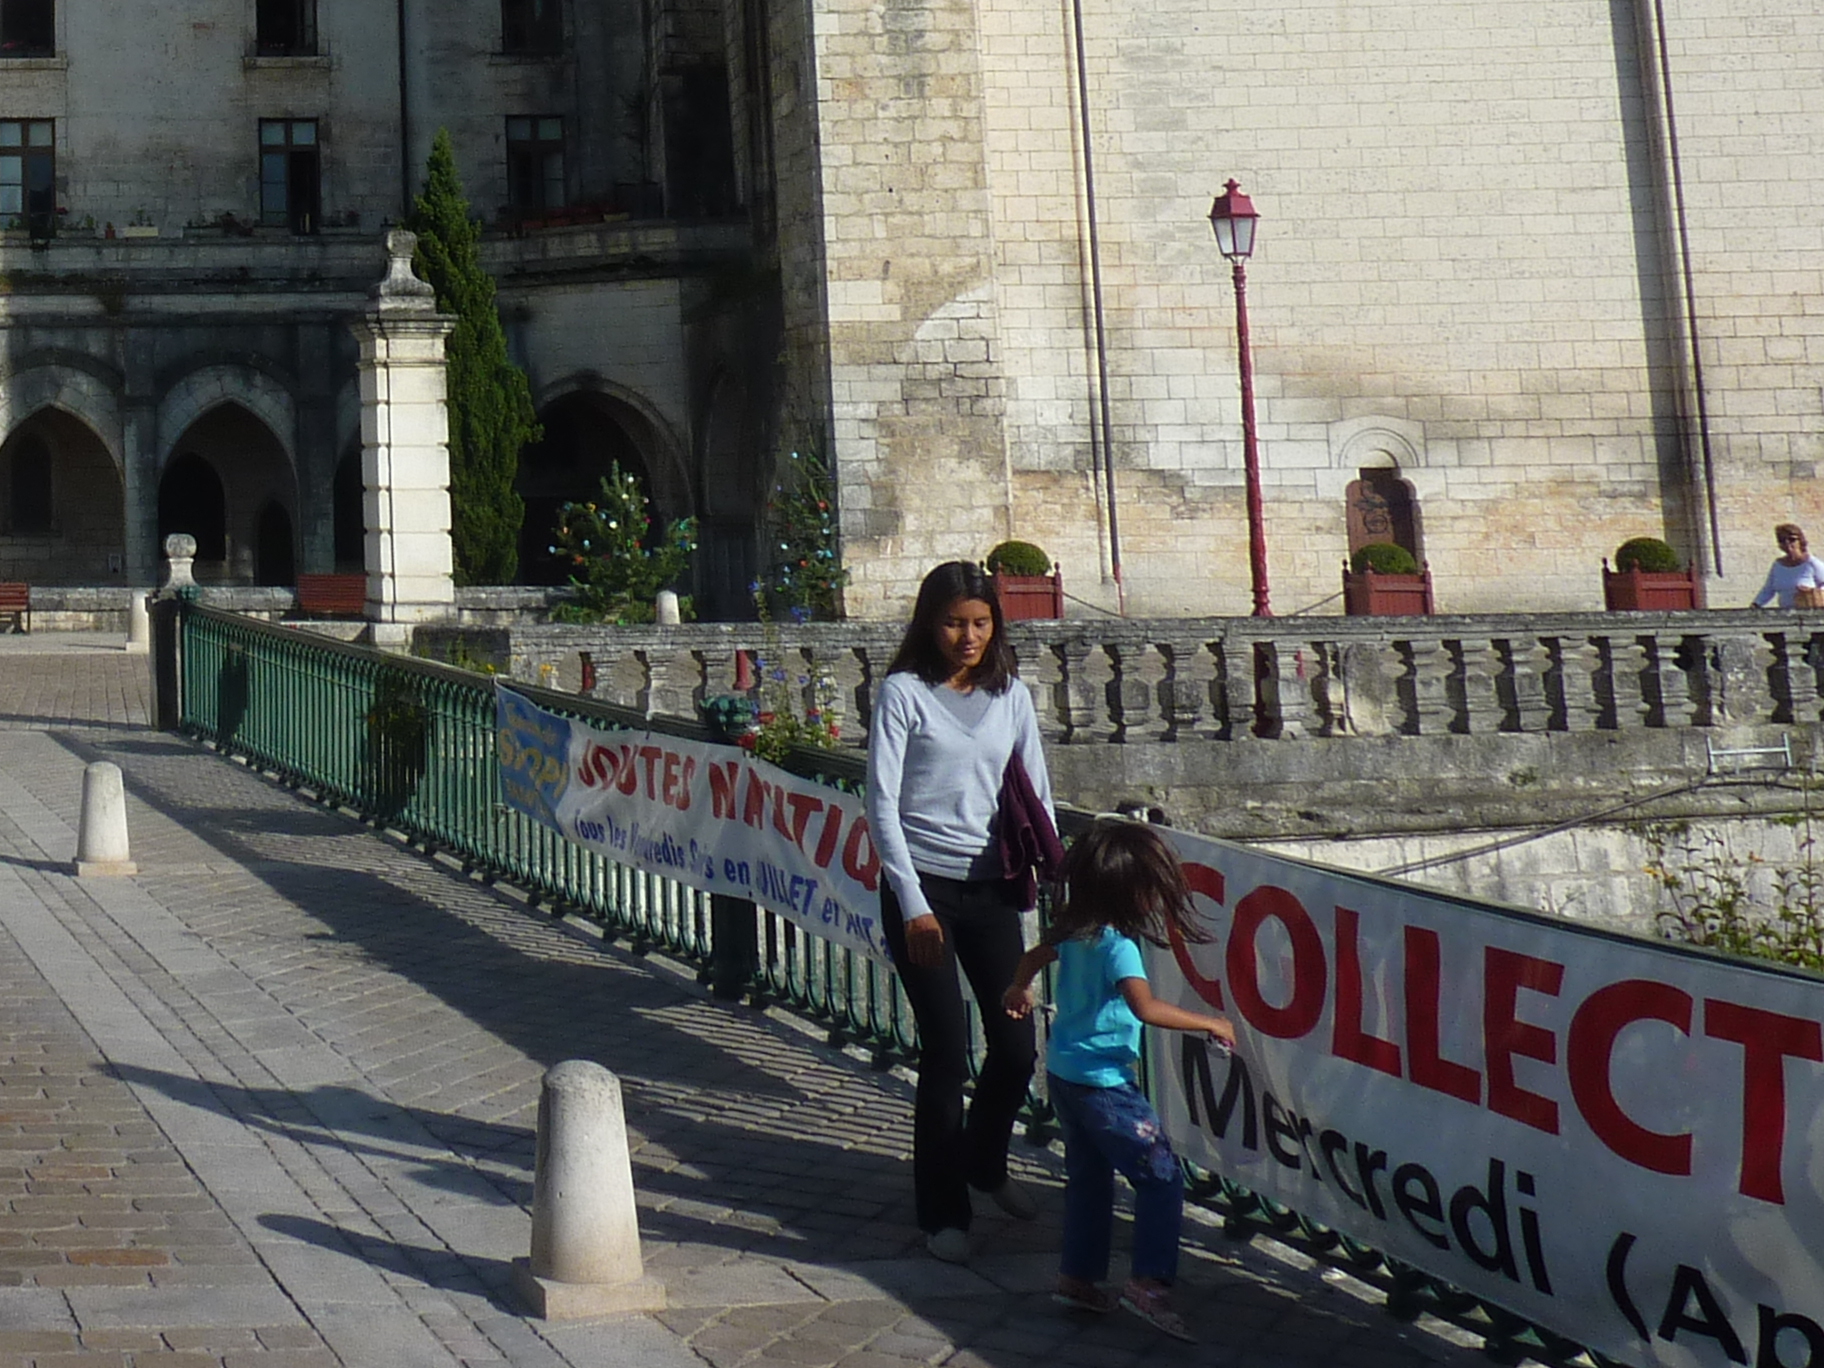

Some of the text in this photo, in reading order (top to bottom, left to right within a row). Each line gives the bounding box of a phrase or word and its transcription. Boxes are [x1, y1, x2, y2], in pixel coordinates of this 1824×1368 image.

[578, 738, 696, 811] JOUTES
[606, 815, 626, 851] les
[723, 857, 751, 886] en
[821, 896, 840, 927] et
[1164, 861, 1824, 1206] COLLECT
[1182, 1034, 1554, 1297] Mercredi
